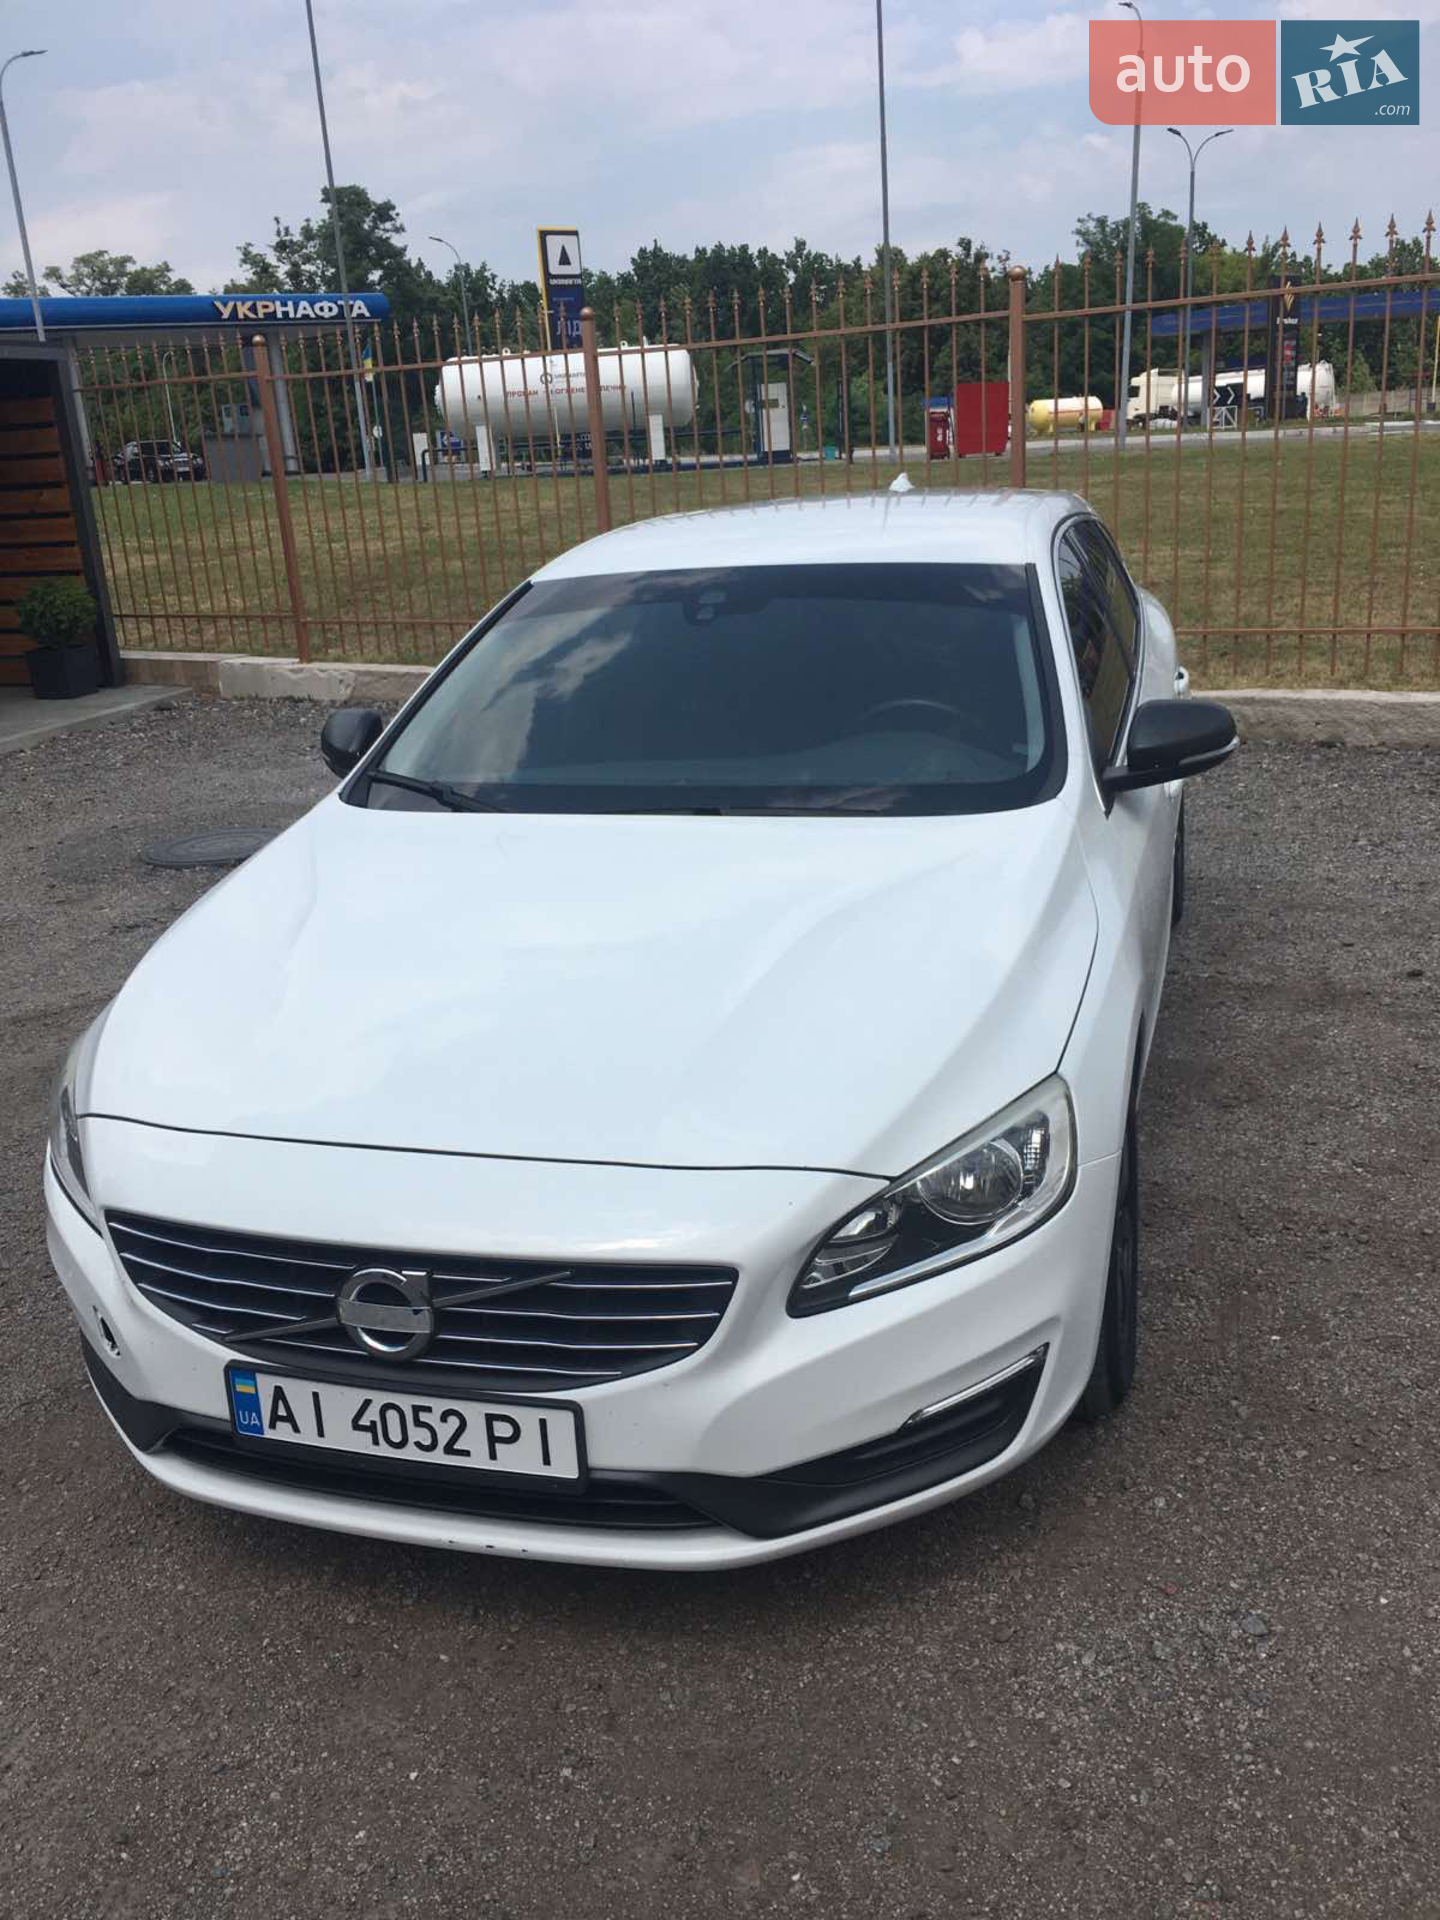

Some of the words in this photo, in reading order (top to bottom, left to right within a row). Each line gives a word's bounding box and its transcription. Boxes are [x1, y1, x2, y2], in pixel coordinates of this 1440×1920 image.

[213, 299, 371, 319] УКРНАФТА
[239, 1409, 261, 1429] UA
[268, 1385, 326, 1438] AI
[351, 1398, 471, 1458] 4052
[485, 1413, 552, 1467] PI
